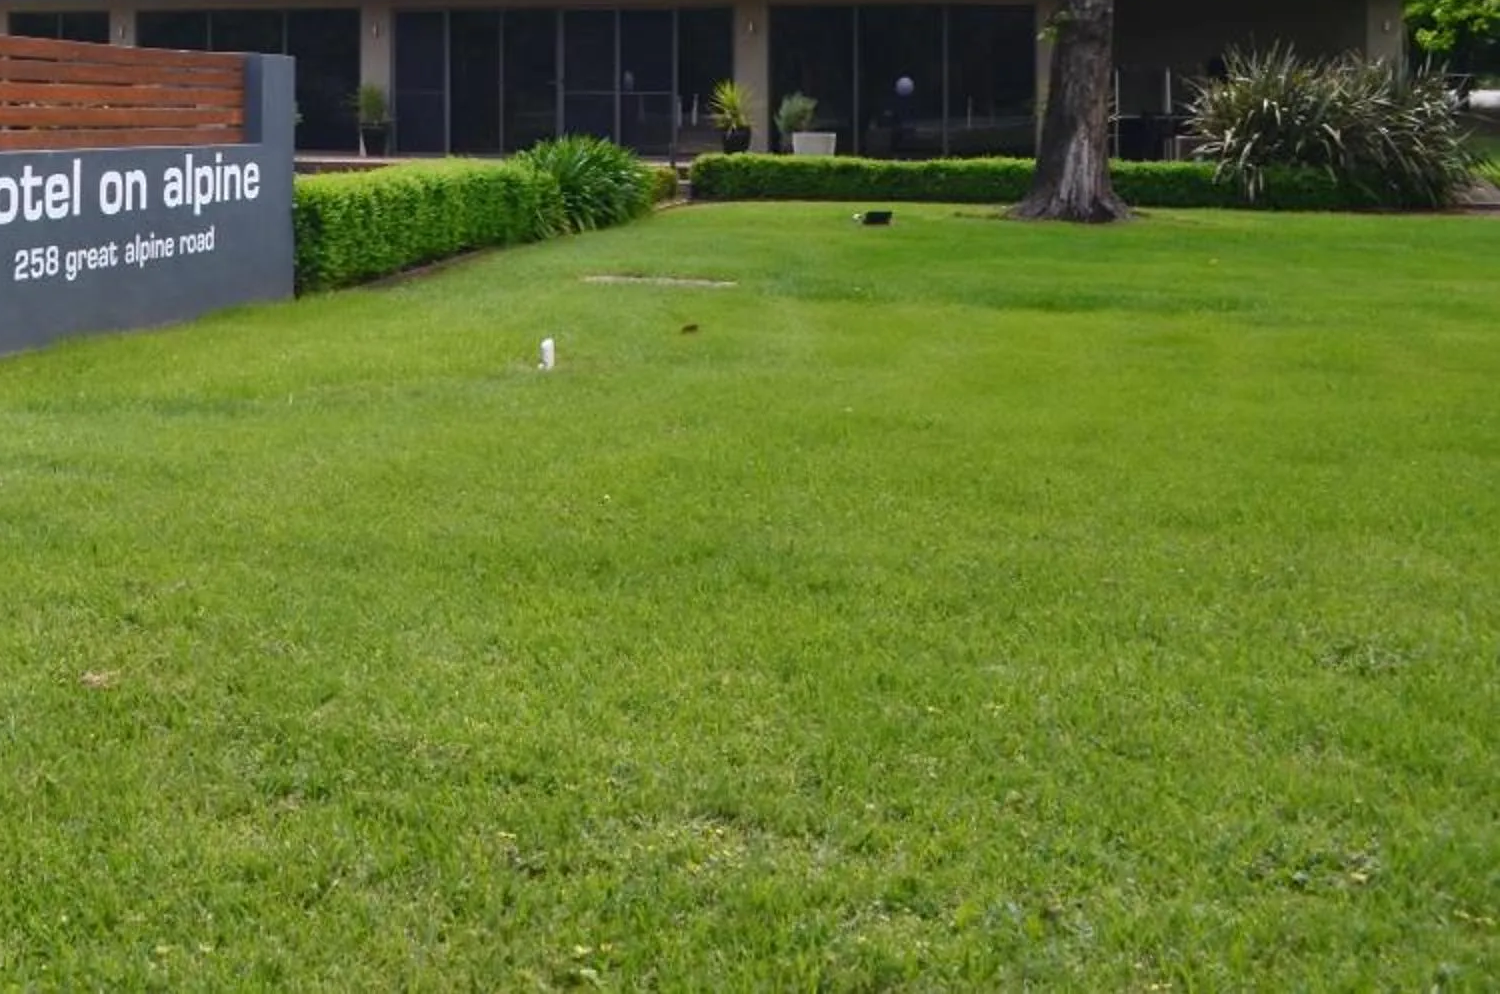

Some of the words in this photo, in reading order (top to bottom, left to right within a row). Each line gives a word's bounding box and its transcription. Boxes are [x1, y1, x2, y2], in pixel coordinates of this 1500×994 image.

[99, 169, 147, 214] on
[163, 153, 260, 214] alpine
[14, 246, 59, 280] 258
[65, 241, 117, 280] great
[125, 233, 174, 268] alpine
[179, 226, 215, 253] road
